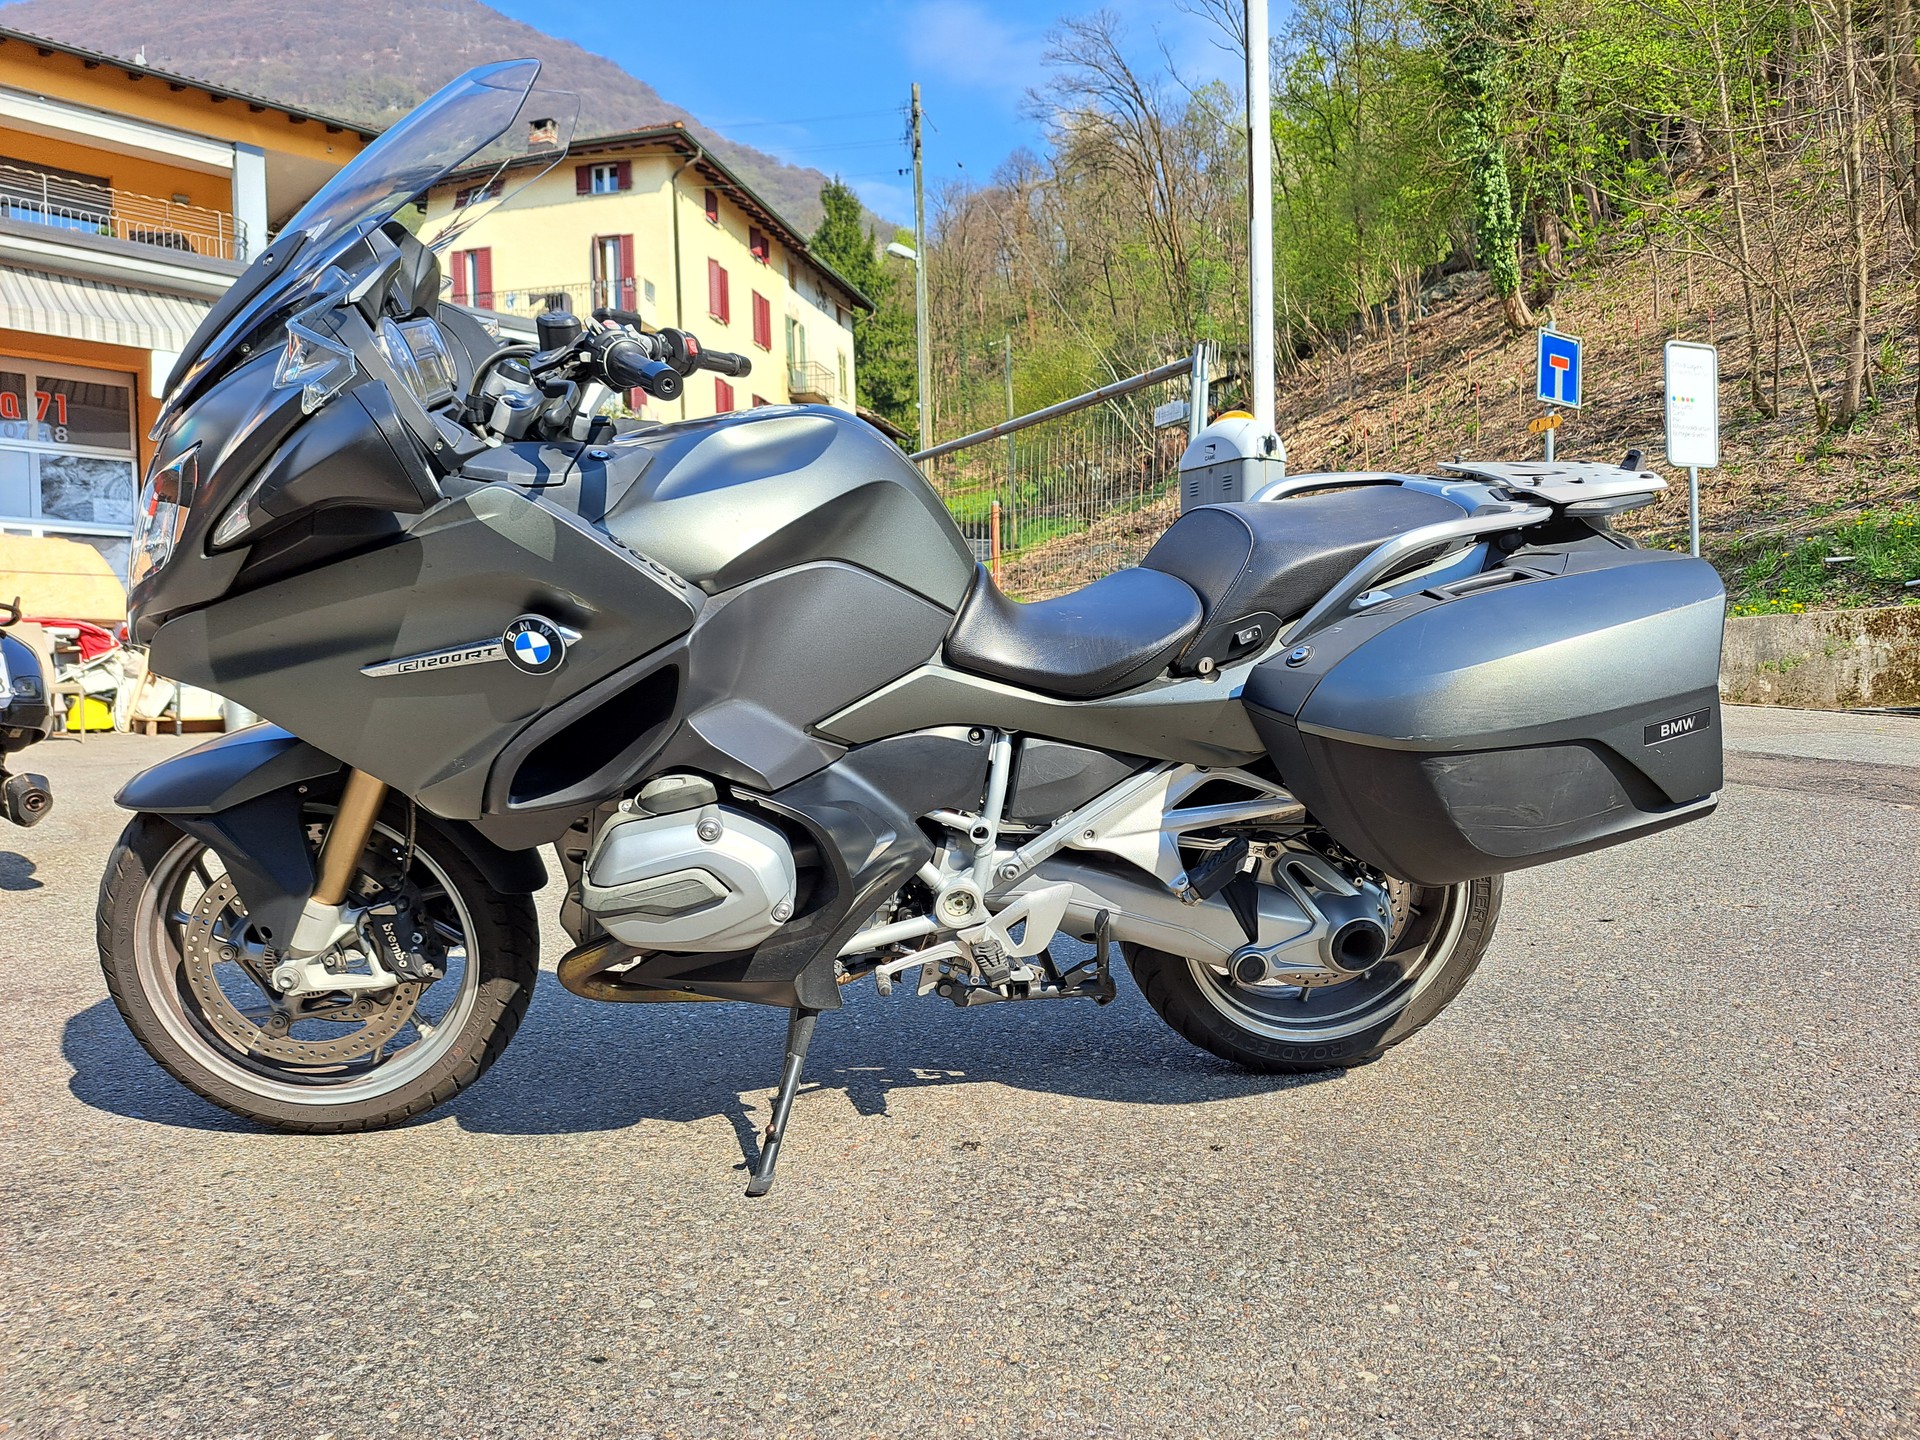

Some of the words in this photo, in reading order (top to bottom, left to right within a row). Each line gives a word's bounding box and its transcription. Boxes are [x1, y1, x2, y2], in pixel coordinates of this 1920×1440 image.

[34, 391, 67, 425] 71
[505, 620, 553, 643] BMW
[1660, 715, 1696, 737] BMW
[381, 922, 408, 968] brembo
